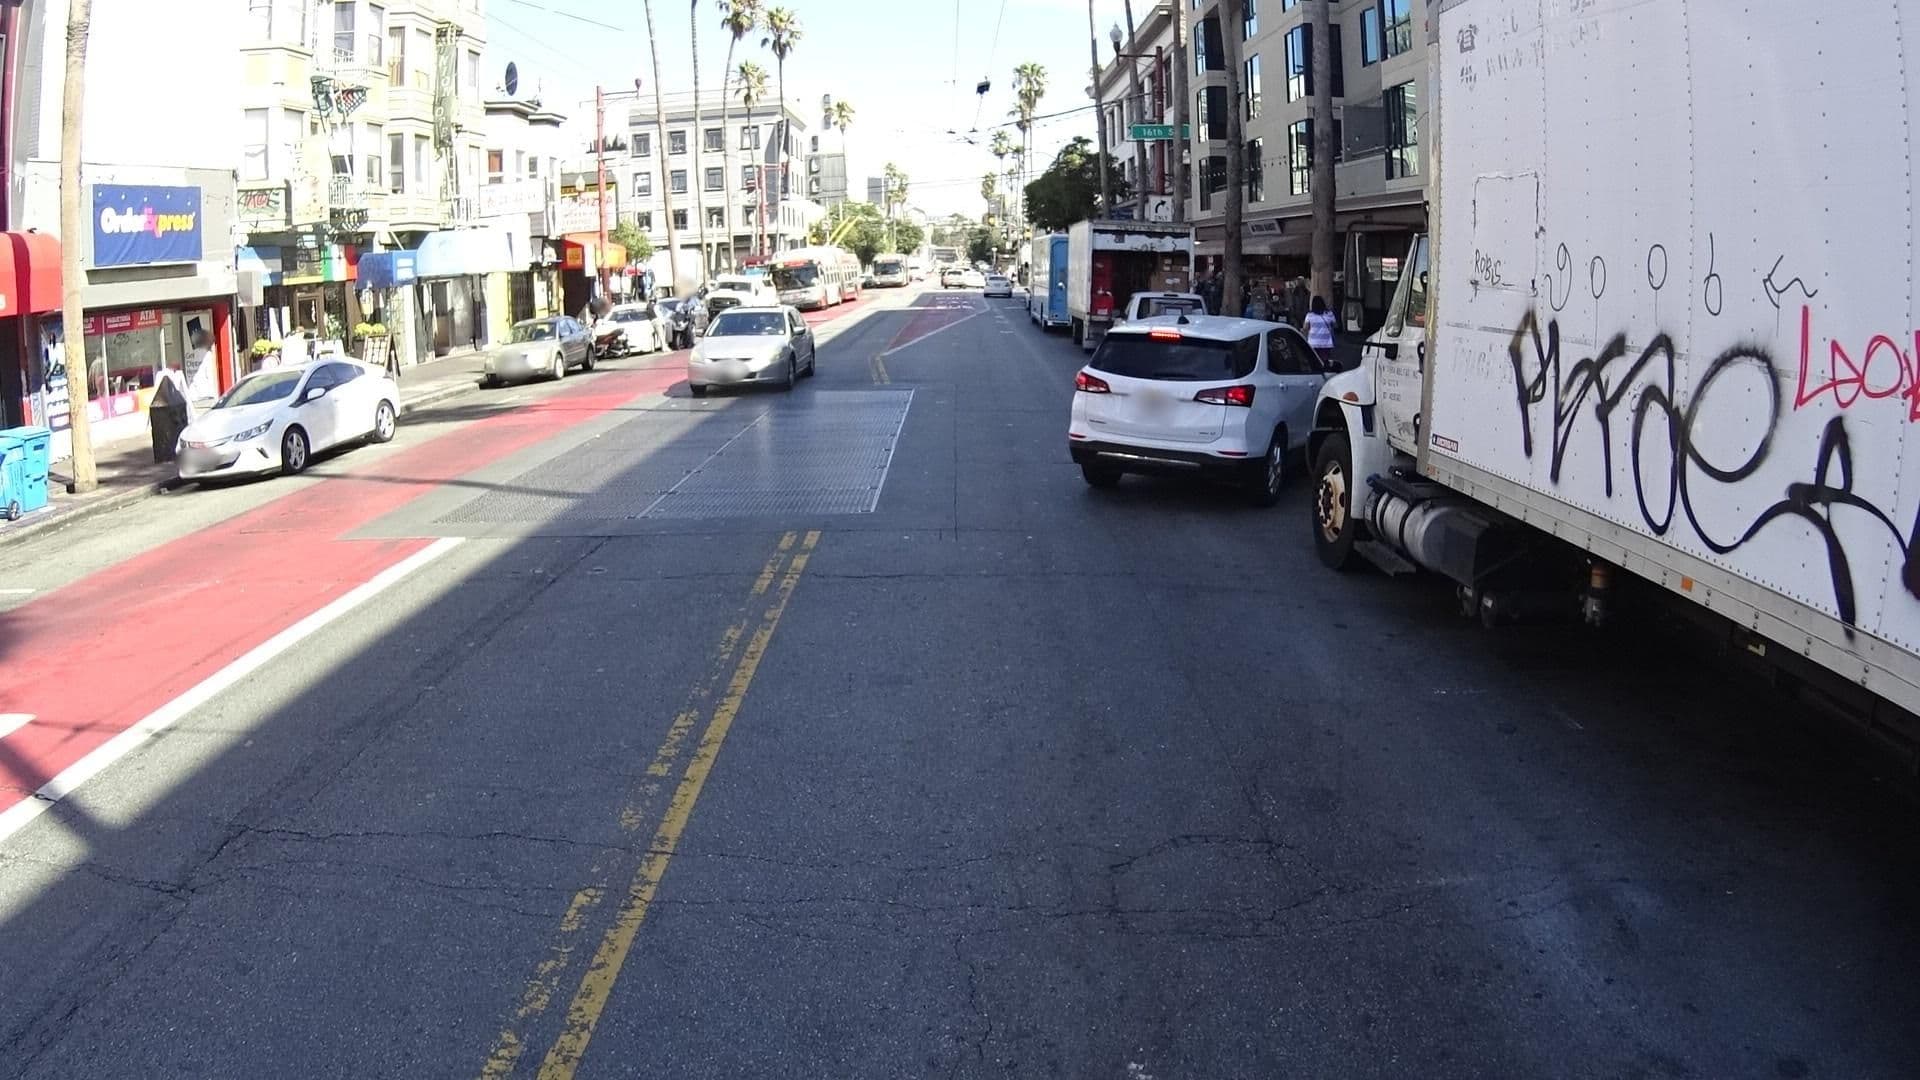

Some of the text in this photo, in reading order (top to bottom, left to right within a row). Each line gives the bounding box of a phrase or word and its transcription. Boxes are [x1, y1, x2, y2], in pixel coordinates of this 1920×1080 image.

[1142, 127, 1163, 136] 16th
[101, 207, 194, 238] OrderExpress
[140, 310, 156, 321] ATM
